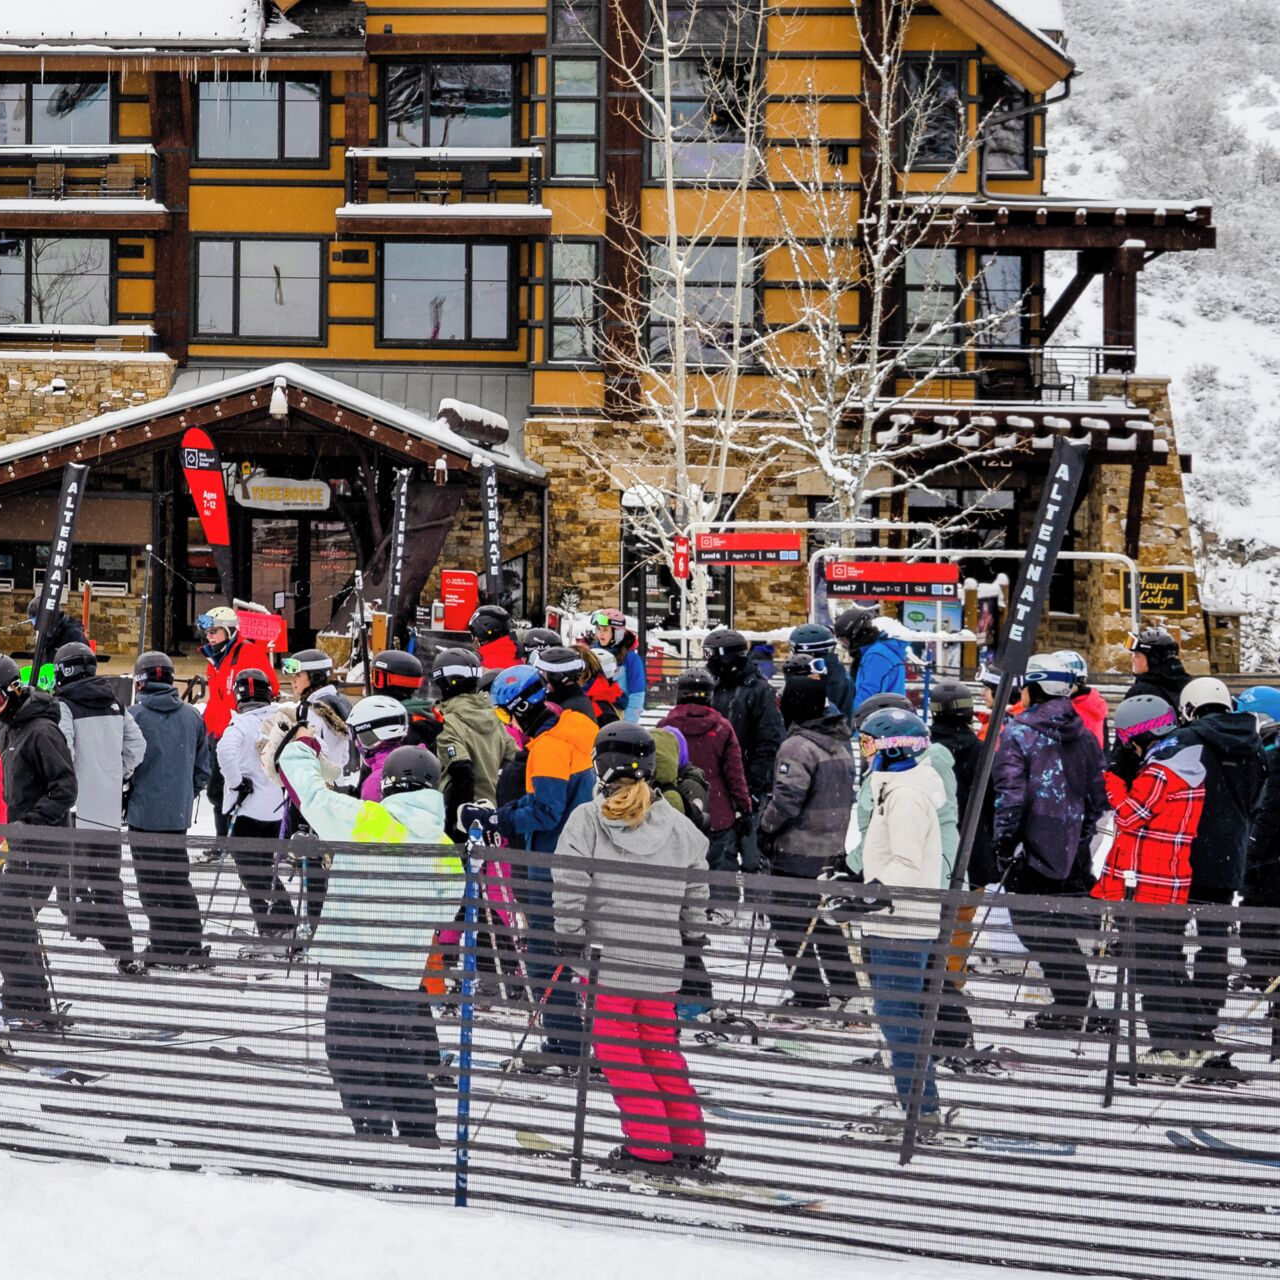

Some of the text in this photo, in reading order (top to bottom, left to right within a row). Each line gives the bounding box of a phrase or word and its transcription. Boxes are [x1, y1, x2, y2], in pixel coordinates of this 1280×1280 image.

[203, 490, 217, 499] Ages
[251, 486, 324, 502] TREEHOUSE
[203, 500, 216, 509] 7-12
[486, 476, 499, 575] ALTERNATE
[45, 482, 78, 610] ALTERNATE
[1009, 463, 1069, 642] ALTERNATE
[678, 557, 684, 572] 6
[1139, 591, 1174, 609] Lodge
